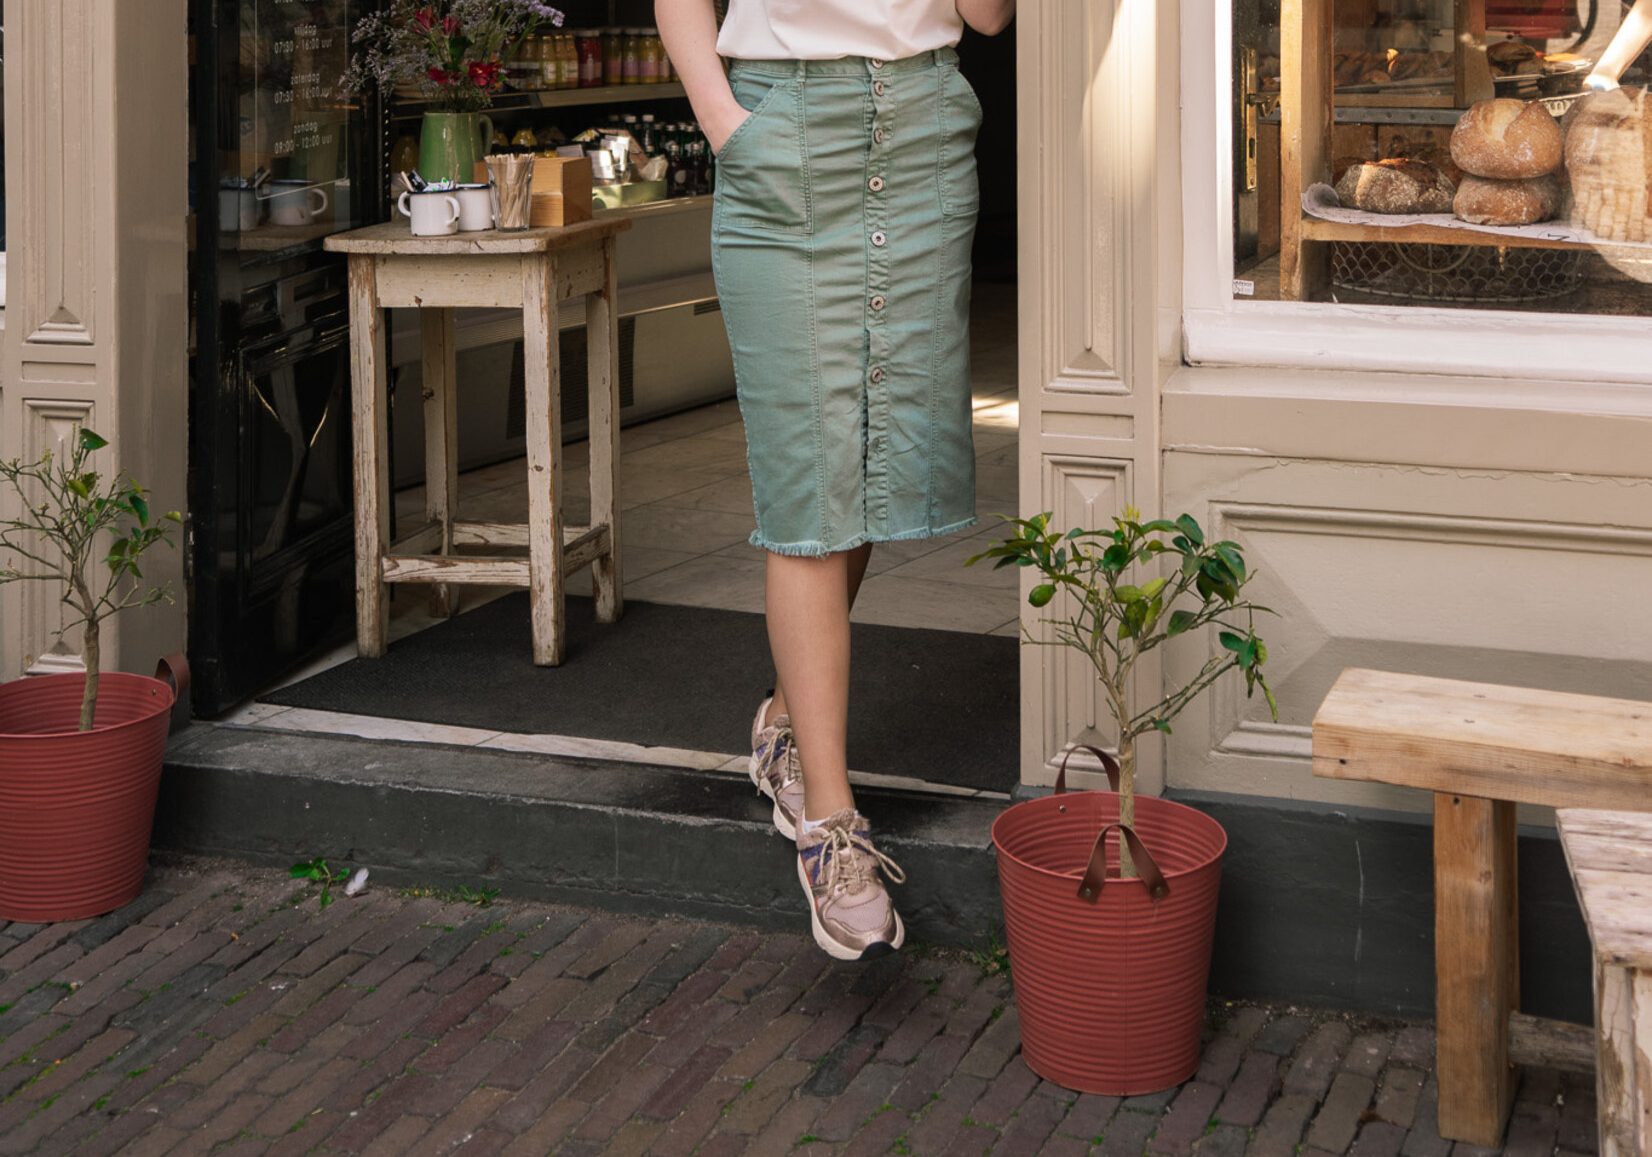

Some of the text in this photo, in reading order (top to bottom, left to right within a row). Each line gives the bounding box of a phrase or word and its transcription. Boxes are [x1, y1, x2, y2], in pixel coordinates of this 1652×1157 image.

[293, 24, 317, 38] vrijdag
[274, 41, 293, 54] 07:30
[301, 38, 320, 51] 16:00
[290, 72, 320, 85] zaterdag
[274, 91, 293, 104] 07:30
[301, 87, 320, 100] 16:00
[293, 122, 318, 134] zondag
